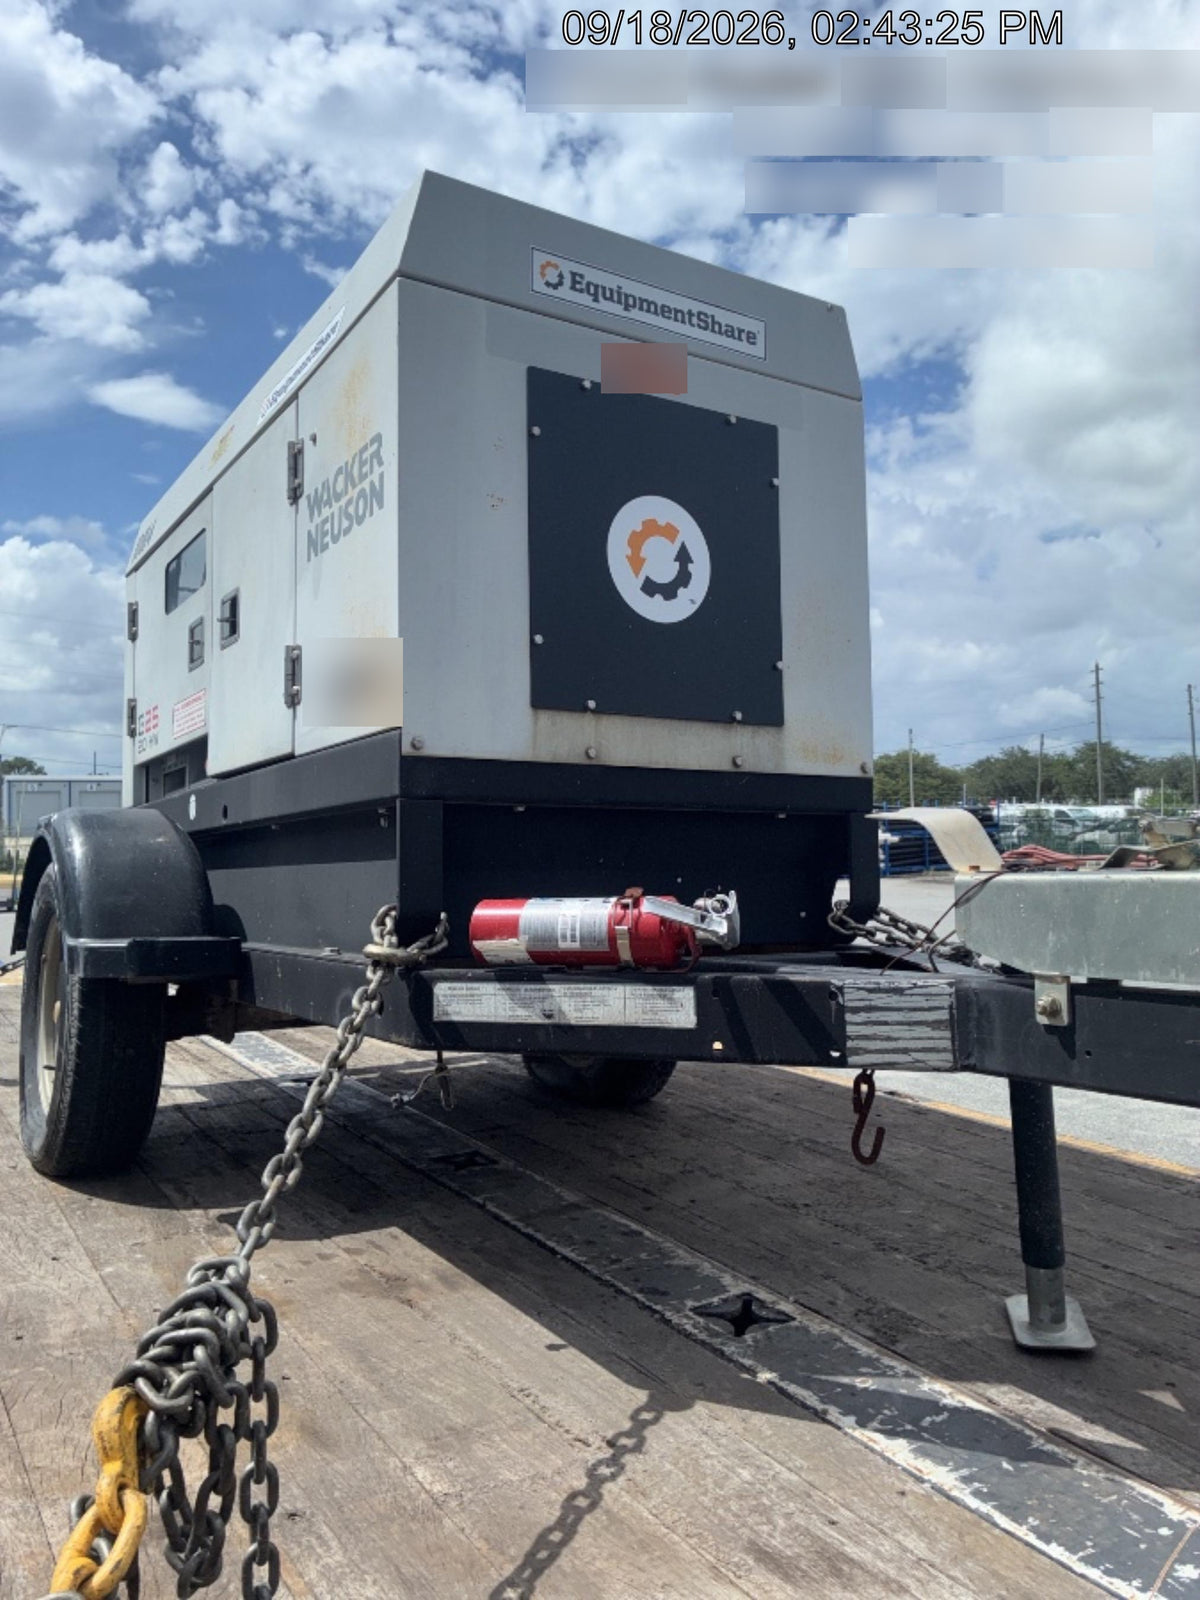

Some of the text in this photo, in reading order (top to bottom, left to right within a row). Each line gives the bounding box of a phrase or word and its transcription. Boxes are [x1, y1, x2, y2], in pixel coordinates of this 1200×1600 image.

[569, 269, 758, 347] EquipmentShare
[306, 431, 385, 524] WACKER
[306, 470, 385, 563] NEUSON
